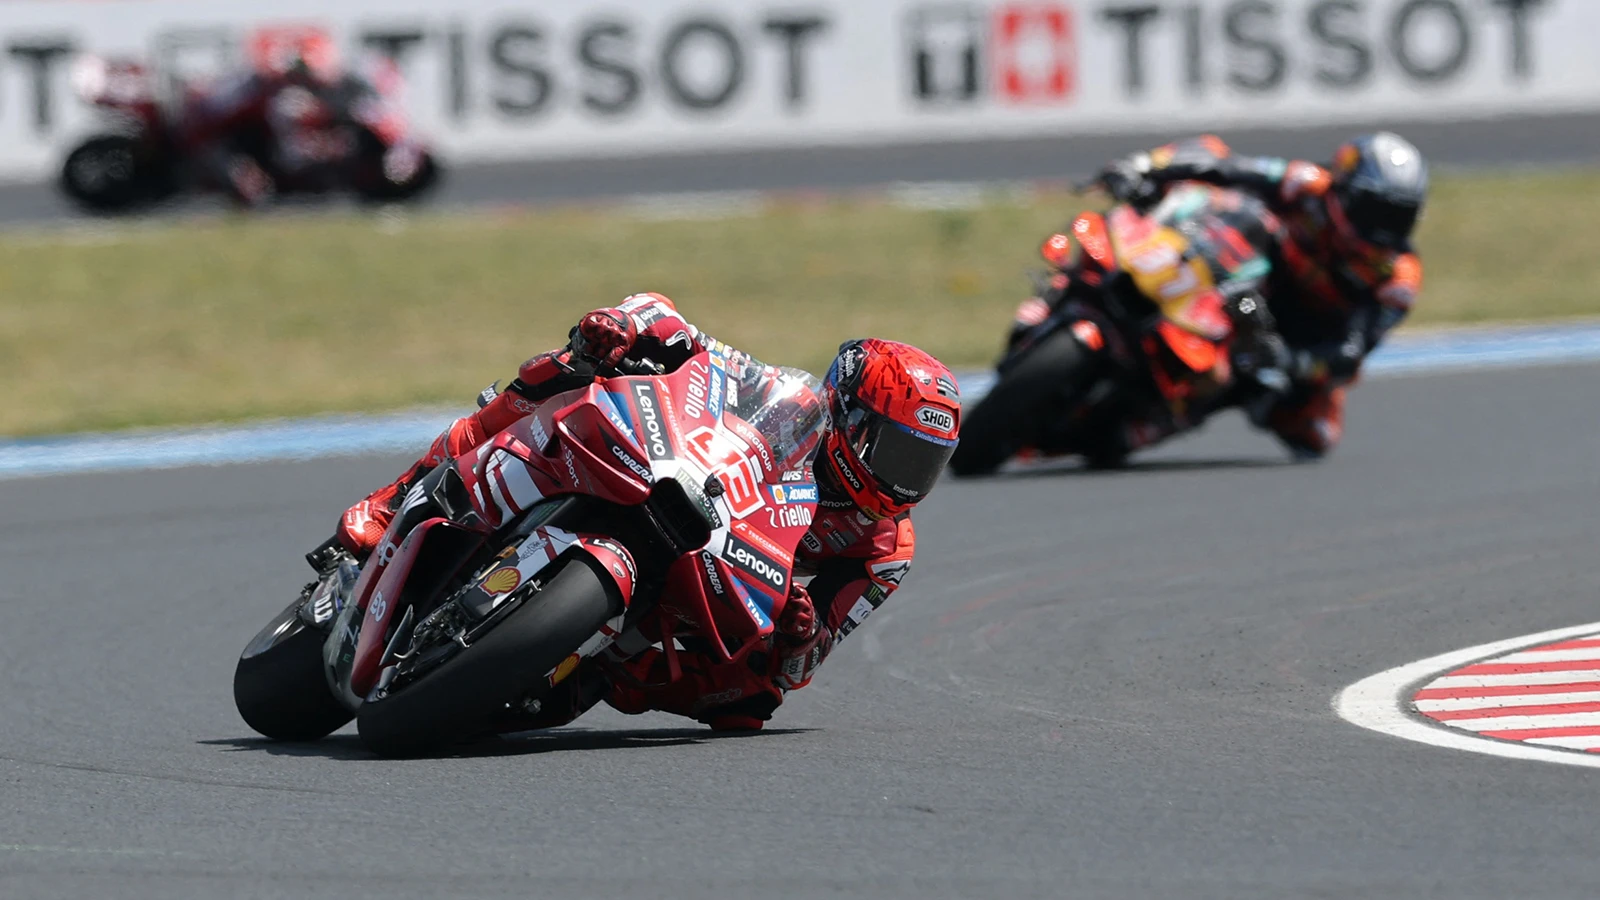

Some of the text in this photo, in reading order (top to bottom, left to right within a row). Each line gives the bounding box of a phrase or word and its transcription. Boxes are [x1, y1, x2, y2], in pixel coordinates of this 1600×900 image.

[1091, 0, 1546, 97] TISSOT
[356, 18, 824, 126] TISSOT
[684, 370, 707, 419] riello
[706, 367, 722, 416] ADVANCE
[726, 377, 739, 408] WRS
[609, 411, 633, 438] TIM
[635, 384, 667, 457] Lenovo
[921, 410, 953, 430] SHOEI
[565, 448, 580, 488] Sport
[612, 445, 655, 483] CARRERA
[781, 470, 804, 481] WRS
[833, 450, 861, 490] Lenovo
[686, 479, 723, 529] MONSTER
[788, 486, 817, 501] ADVANCE
[819, 500, 853, 509] Lenovo
[892, 483, 920, 498] Insta360
[778, 504, 813, 528] riello
[747, 529, 792, 563] FRECCIAROSSA
[803, 532, 820, 550] OEI
[832, 529, 848, 548] Lenovo
[592, 538, 638, 596] Lenovo
[701, 551, 724, 596] CARRERA
[726, 538, 785, 587] Lenovo
[746, 597, 765, 628] TIM
